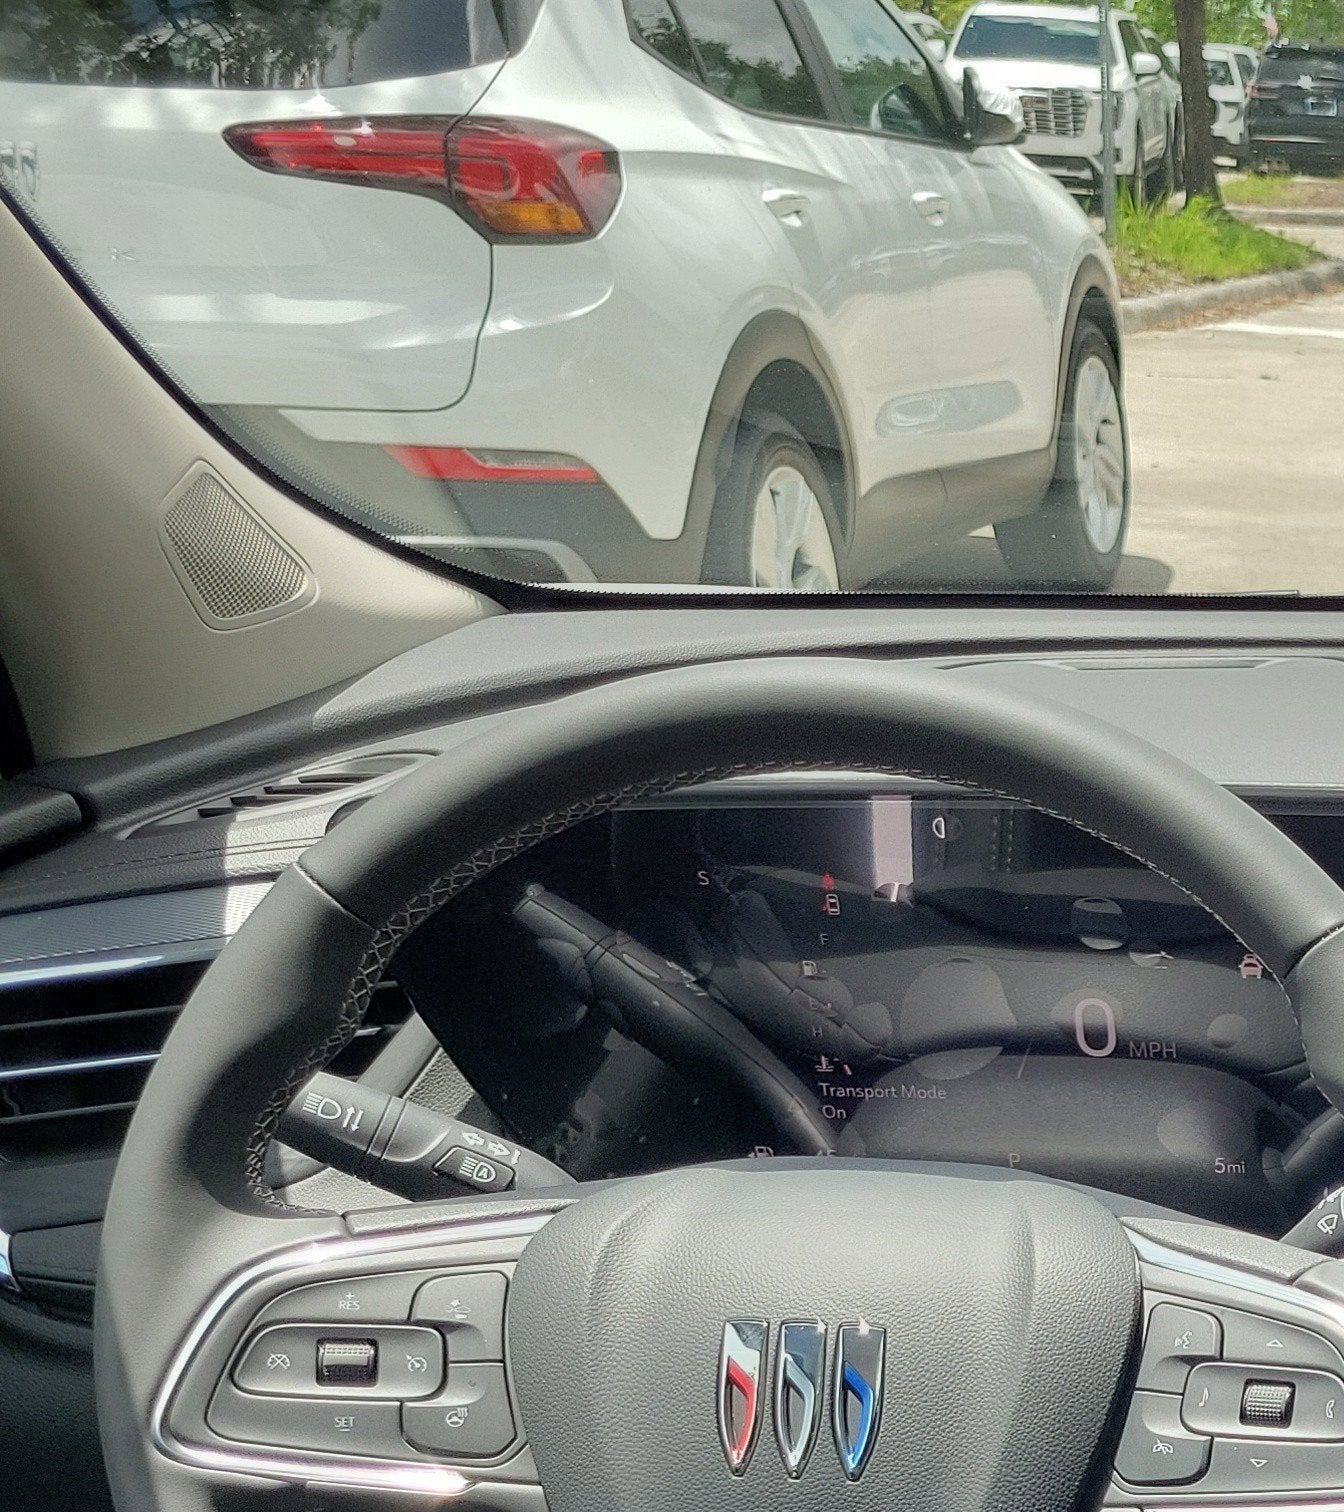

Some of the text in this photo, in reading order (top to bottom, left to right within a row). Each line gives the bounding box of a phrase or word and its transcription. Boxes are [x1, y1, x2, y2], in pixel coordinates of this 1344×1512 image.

[698, 870, 710, 886] S
[1074, 998, 1117, 1057] 0
[1129, 1041, 1177, 1059] MPH
[818, 1082, 947, 1100] Transport Mode
[822, 1105, 847, 1119] On
[1009, 1153, 1021, 1168] P
[339, 1300, 360, 1311] RES
[334, 1416, 355, 1428] SET
